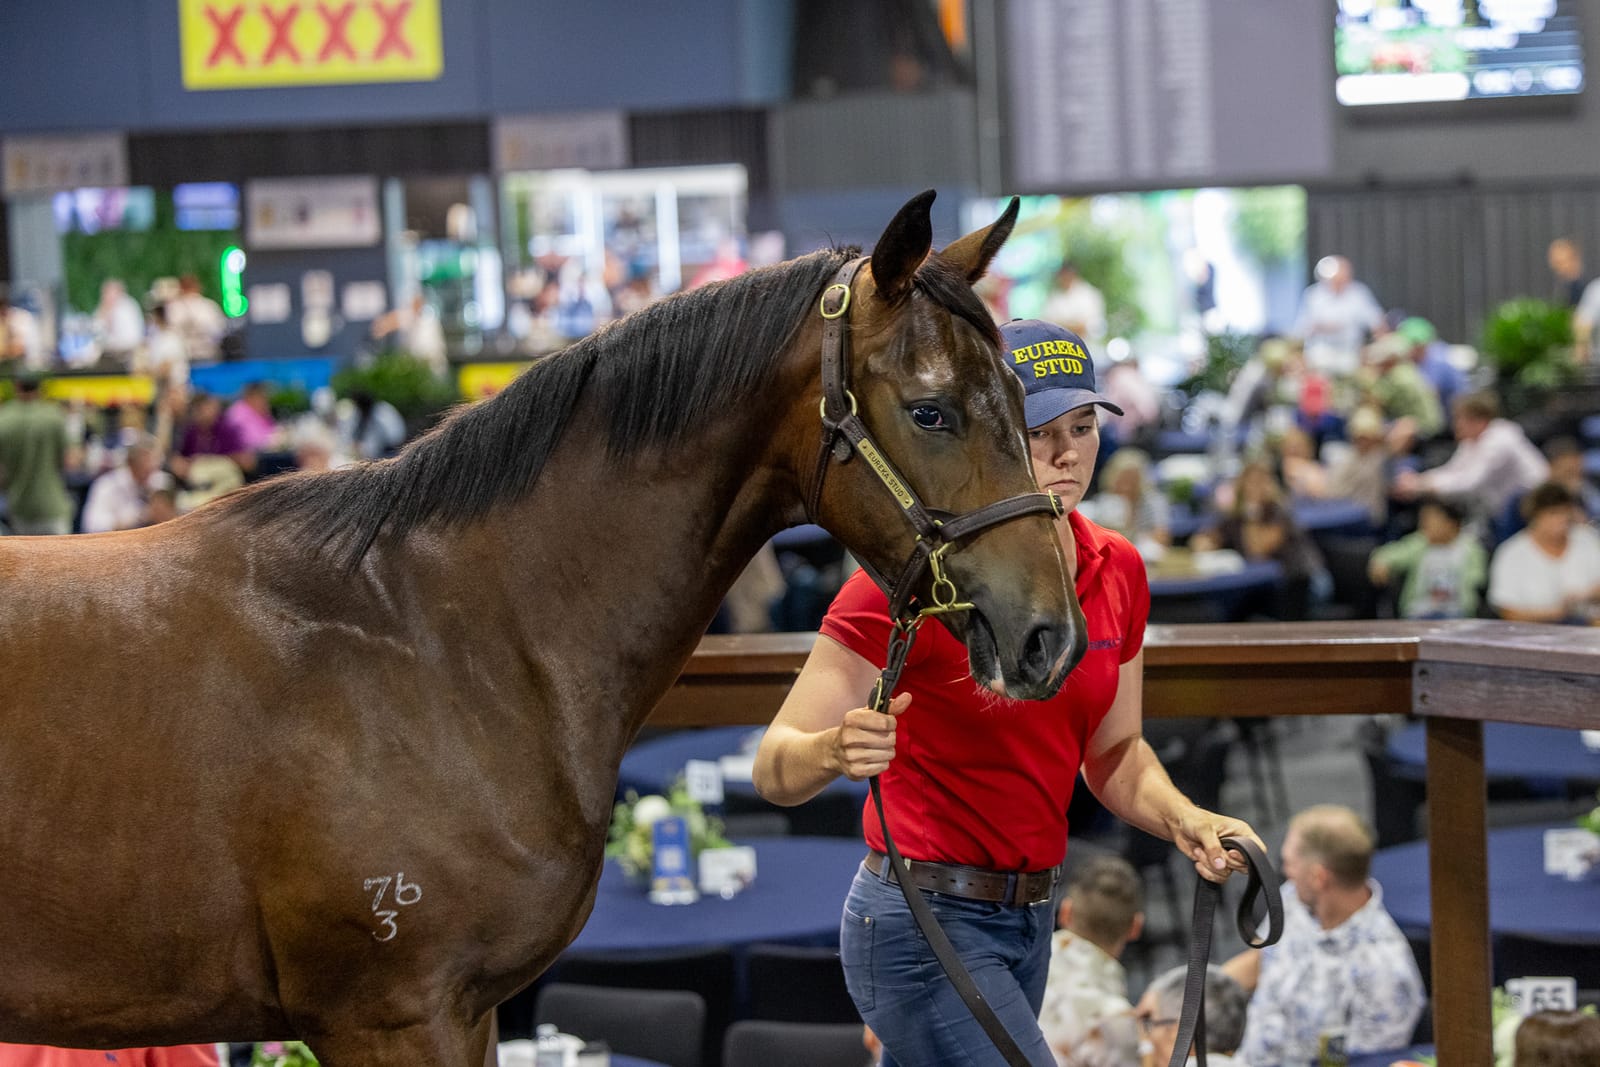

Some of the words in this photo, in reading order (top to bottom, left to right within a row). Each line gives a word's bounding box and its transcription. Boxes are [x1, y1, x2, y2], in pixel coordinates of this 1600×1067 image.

[203, 0, 414, 68] XXXX
[1012, 340, 1088, 365] EUREKA
[1033, 358, 1083, 378] STUD
[867, 451, 890, 479] EUREKA
[888, 479, 904, 497] STUD
[372, 910, 399, 942] 3
